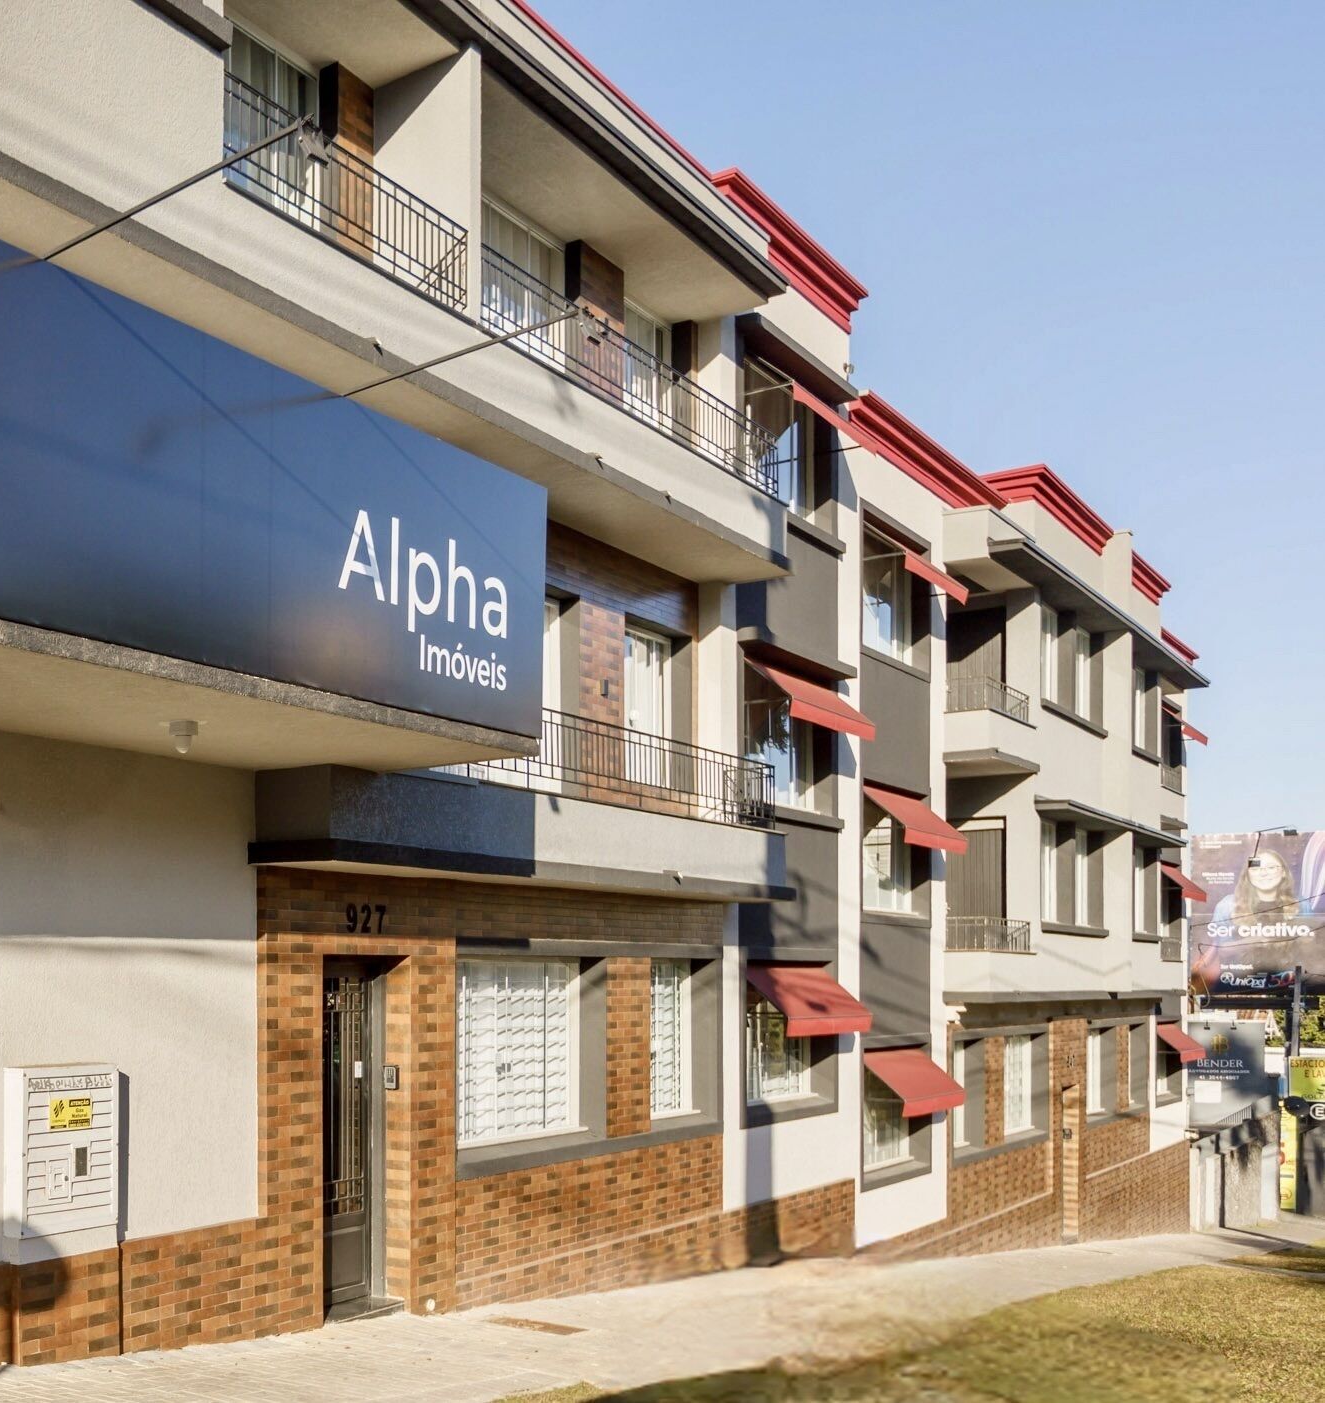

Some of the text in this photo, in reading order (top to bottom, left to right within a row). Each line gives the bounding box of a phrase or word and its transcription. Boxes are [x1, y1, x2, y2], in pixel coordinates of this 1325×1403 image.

[338, 509, 507, 639] Alpha
[419, 634, 507, 691] Imóveis
[346, 902, 387, 935] 927
[1207, 922, 1315, 937] Ser criativo.
[1197, 1058, 1244, 1068] BENDER
